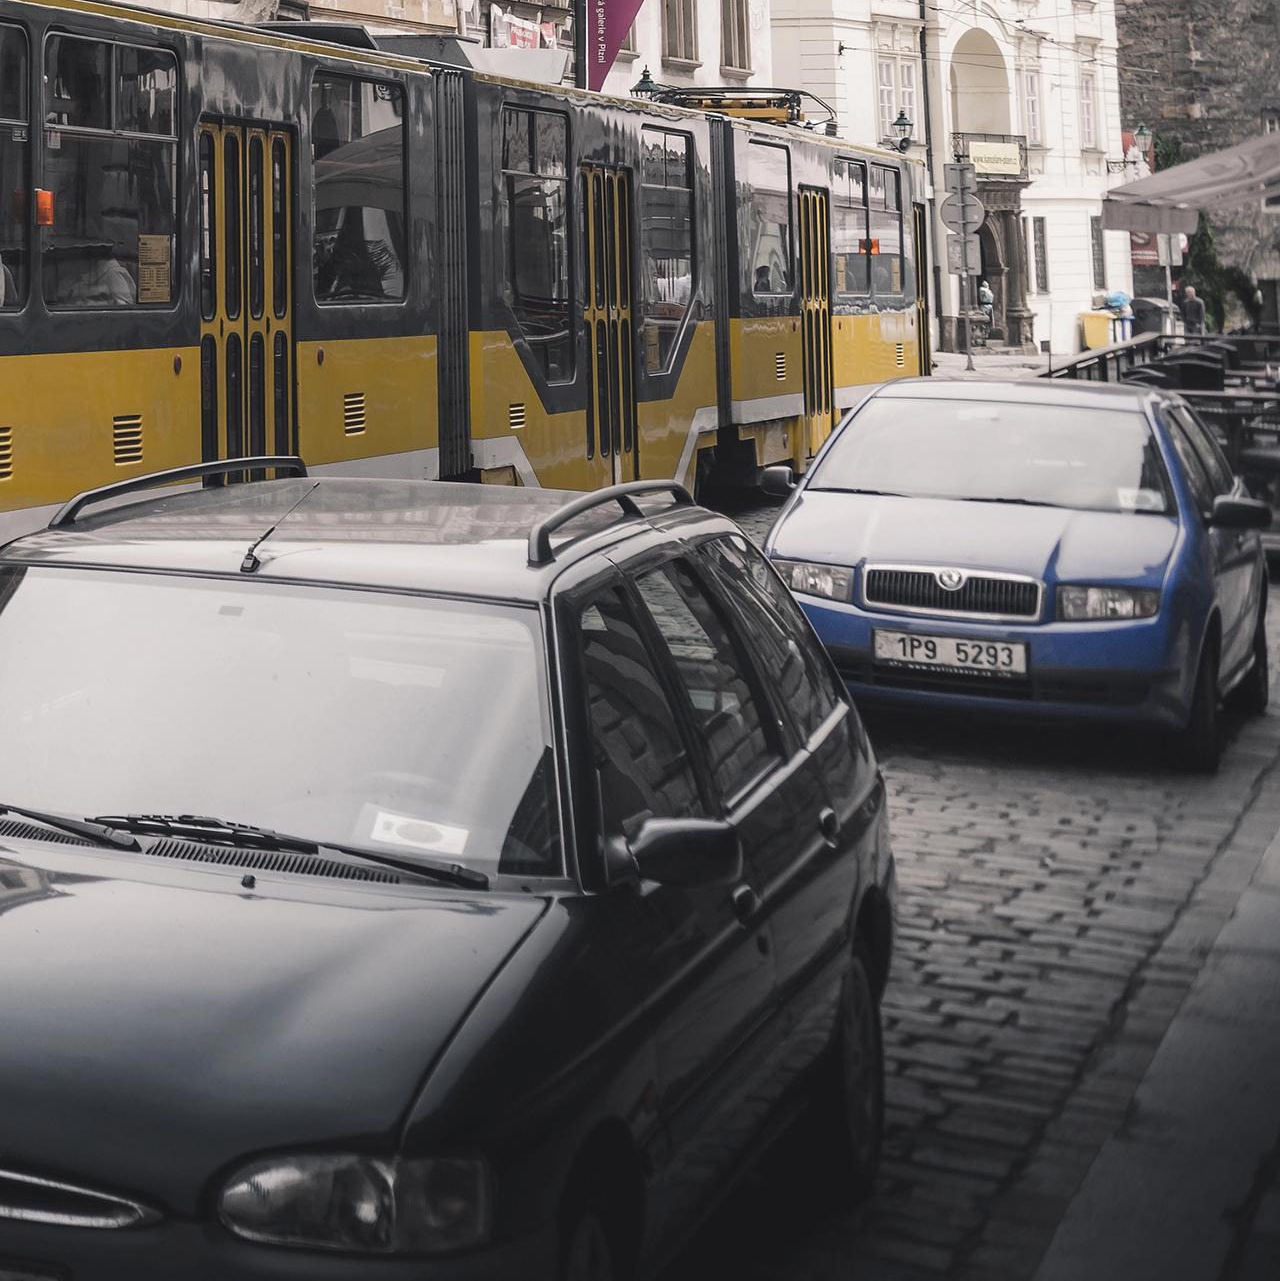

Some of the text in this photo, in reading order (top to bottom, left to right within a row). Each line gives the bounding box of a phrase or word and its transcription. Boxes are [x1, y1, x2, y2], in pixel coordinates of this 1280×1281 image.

[596, 8, 607, 35] galerie
[597, 43, 607, 64] Plzni
[898, 636, 1014, 667] 1P9 5293
